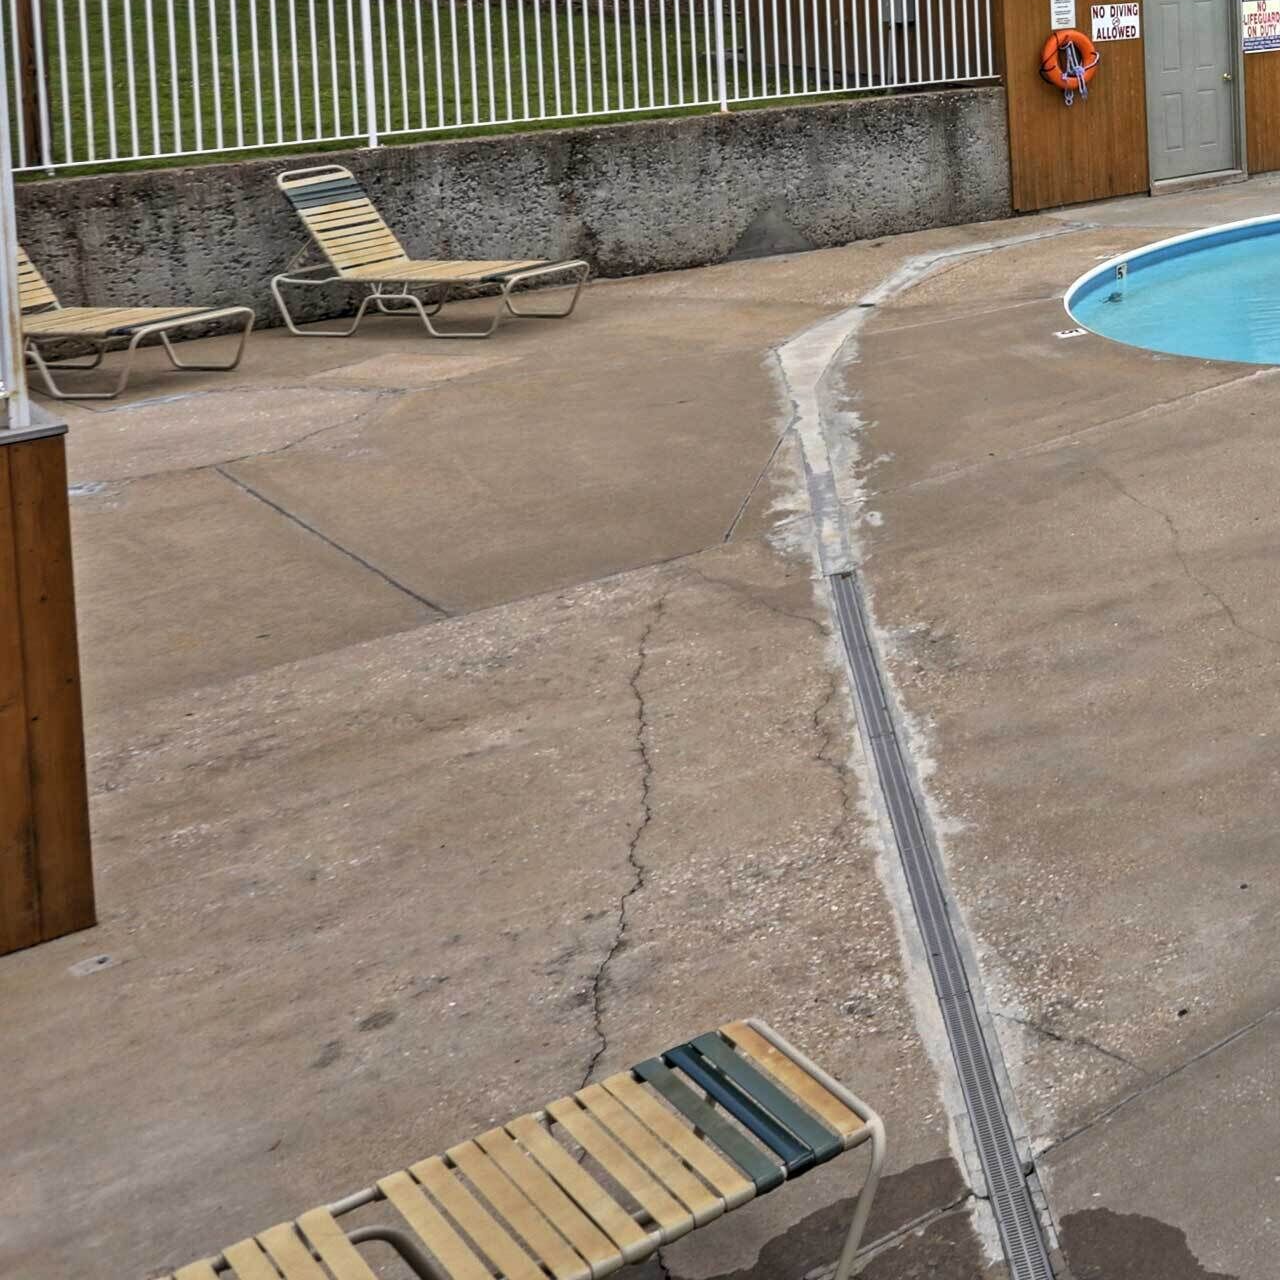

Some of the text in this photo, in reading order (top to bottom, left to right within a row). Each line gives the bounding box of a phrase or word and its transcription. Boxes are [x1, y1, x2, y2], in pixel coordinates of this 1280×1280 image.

[1092, 3, 1138, 19] NO DIVING
[1257, 0, 1266, 12] NO
[1243, 11, 1280, 26] LIFEGUARD
[1096, 25, 1137, 40] ALLOWED
[1247, 23, 1277, 38] ON DUTY
